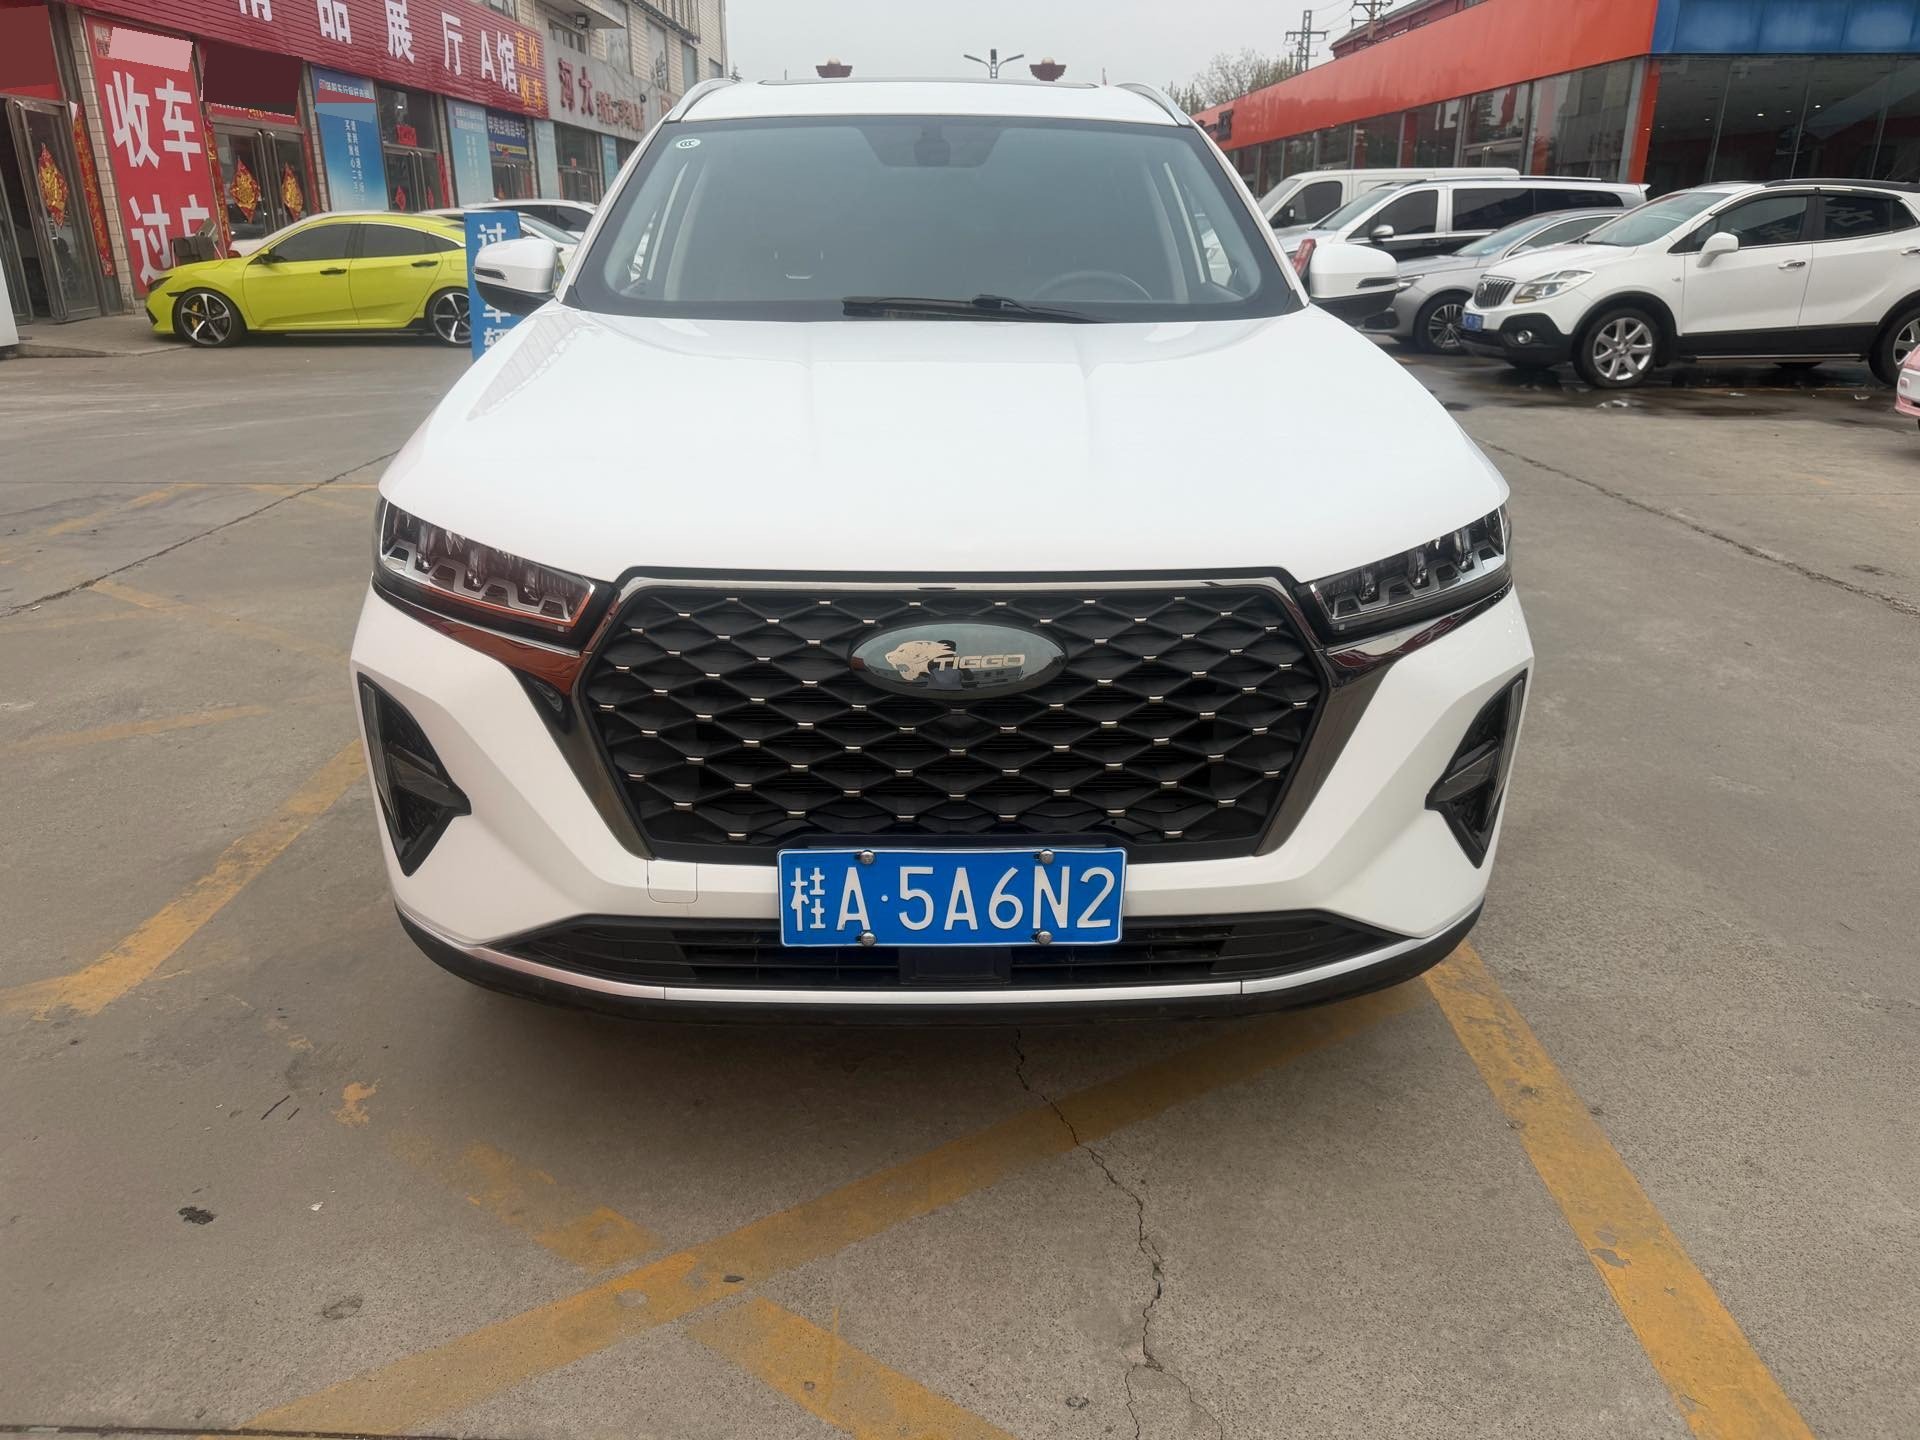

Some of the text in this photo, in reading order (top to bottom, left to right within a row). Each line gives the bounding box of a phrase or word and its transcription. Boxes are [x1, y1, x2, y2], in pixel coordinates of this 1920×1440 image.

[105, 70, 201, 172] 收车
[933, 654, 1026, 672] TIGGO
[790, 866, 1116, 931] 桂A·5A6N2
